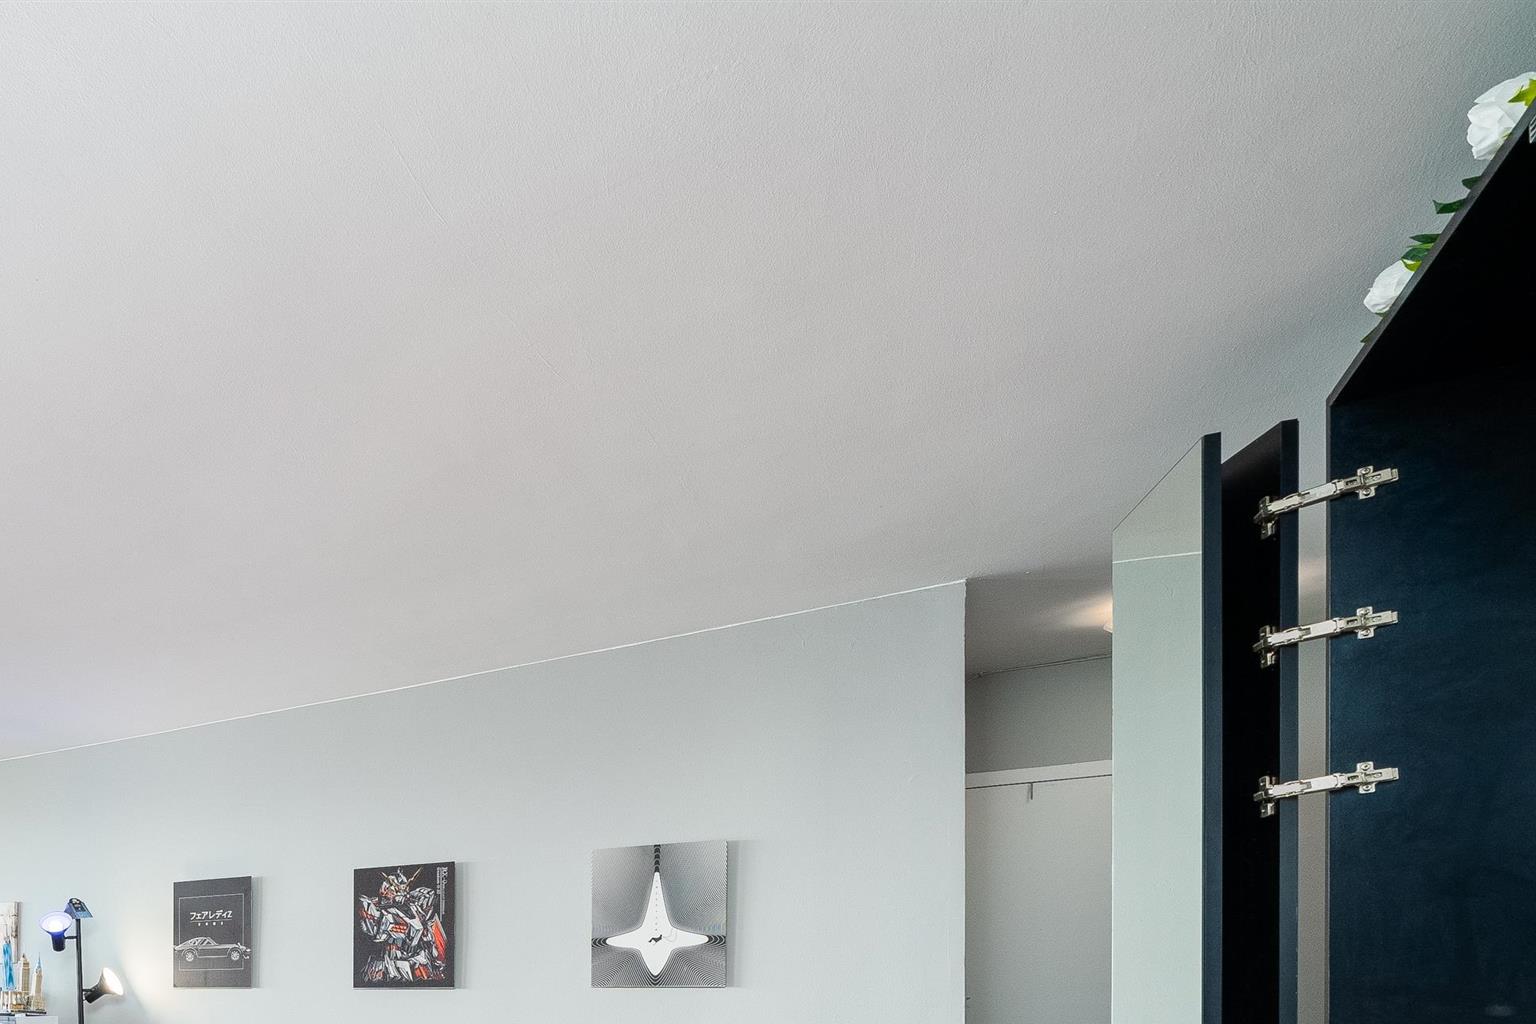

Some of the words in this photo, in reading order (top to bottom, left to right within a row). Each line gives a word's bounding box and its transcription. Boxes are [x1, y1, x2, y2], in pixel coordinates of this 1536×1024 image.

[189, 909, 233, 920] フェアレディZ
